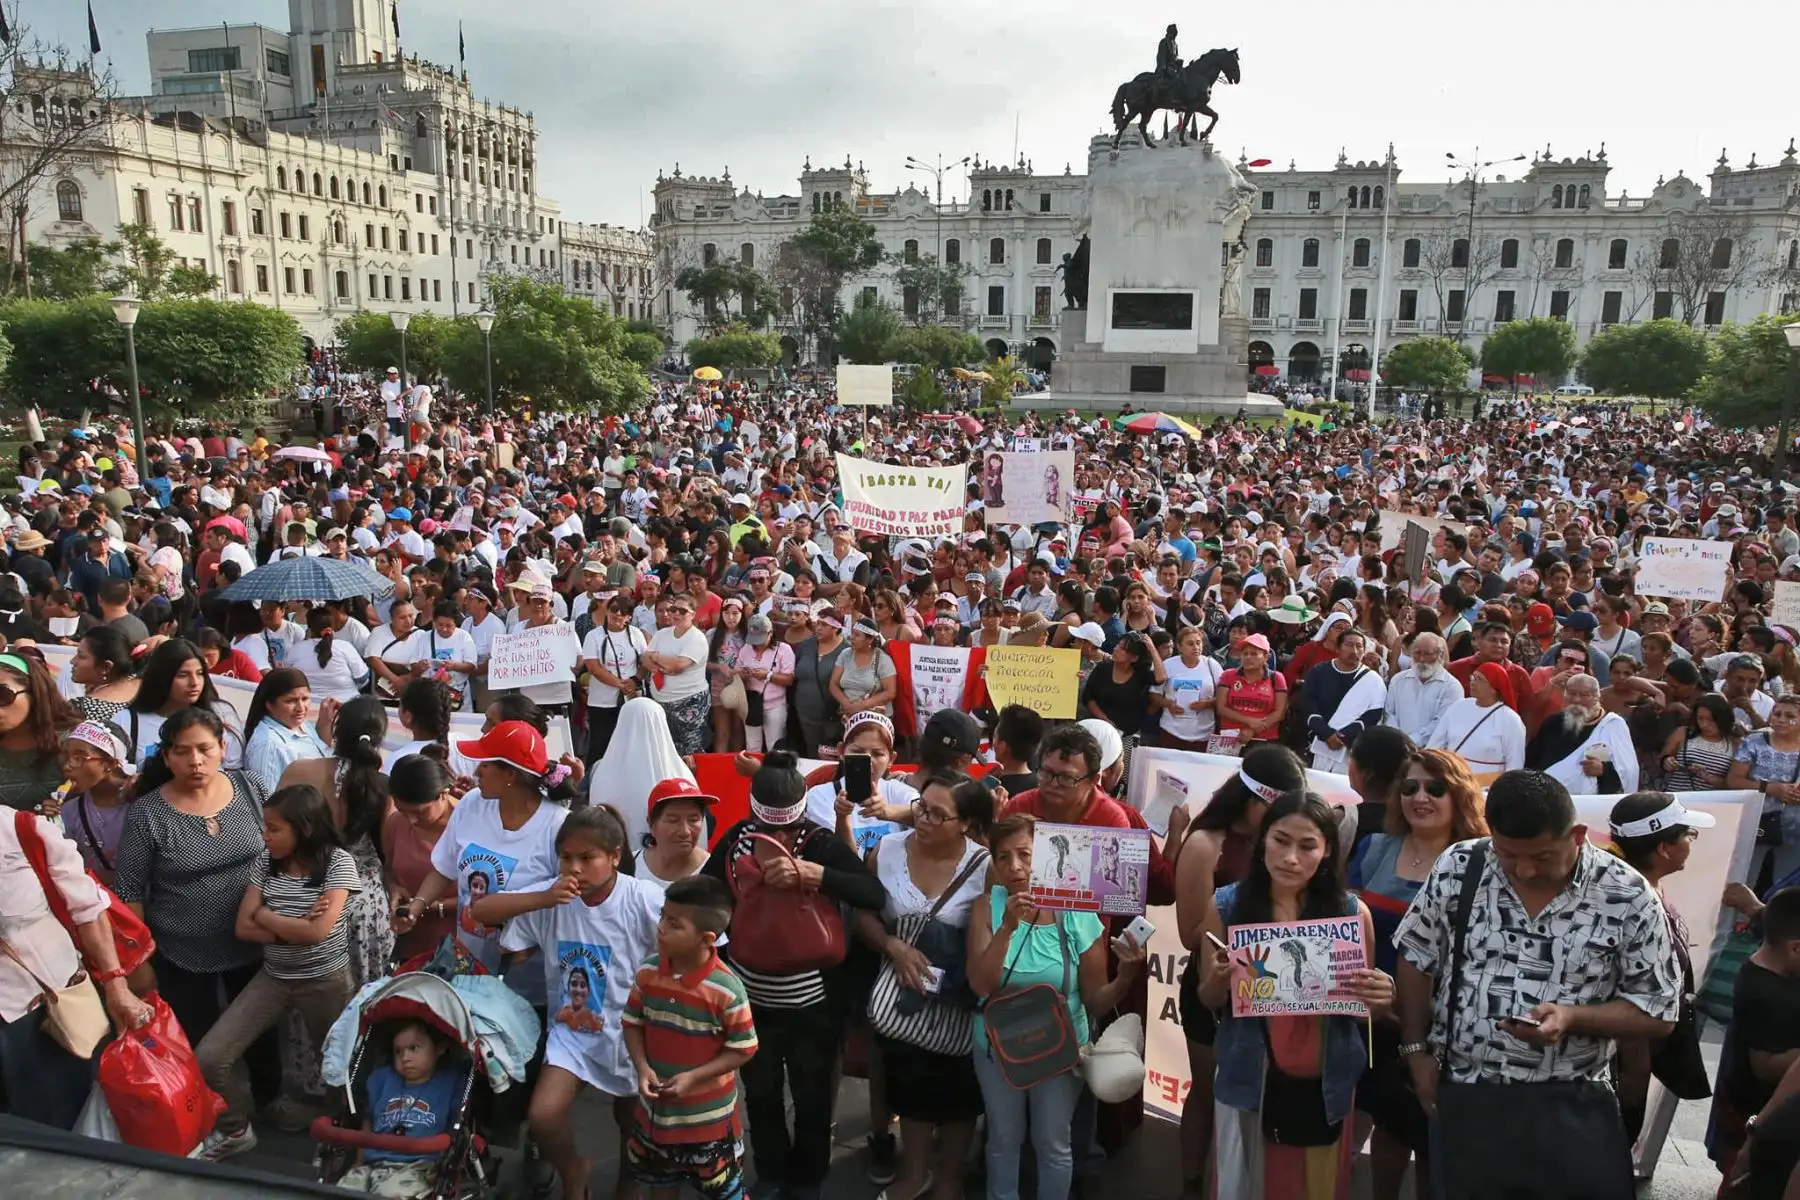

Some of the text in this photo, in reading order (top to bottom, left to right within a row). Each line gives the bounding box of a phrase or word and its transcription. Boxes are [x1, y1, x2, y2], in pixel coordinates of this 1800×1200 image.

[899, 511, 907, 522] Y
[908, 511, 928, 523] PAZ
[933, 507, 964, 521] PARA
[852, 516, 952, 536] NUESTROS HIJOS
[990, 649, 1055, 664] Queremos
[494, 667, 509, 679] POR
[928, 665, 936, 673] PAZ
[1013, 684, 1060, 694] nuestros
[1256, 785, 1277, 800] JIM
[1648, 818, 1662, 832] FJ
[1231, 921, 1360, 950] JIMENA RENACE
[1329, 949, 1363, 962] MARCHA
[1238, 976, 1275, 999] NO
[1252, 1003, 1283, 1013] ABUSO
[1287, 1002, 1320, 1012] SEXUAL
[1322, 1001, 1367, 1013] INFANTIL
